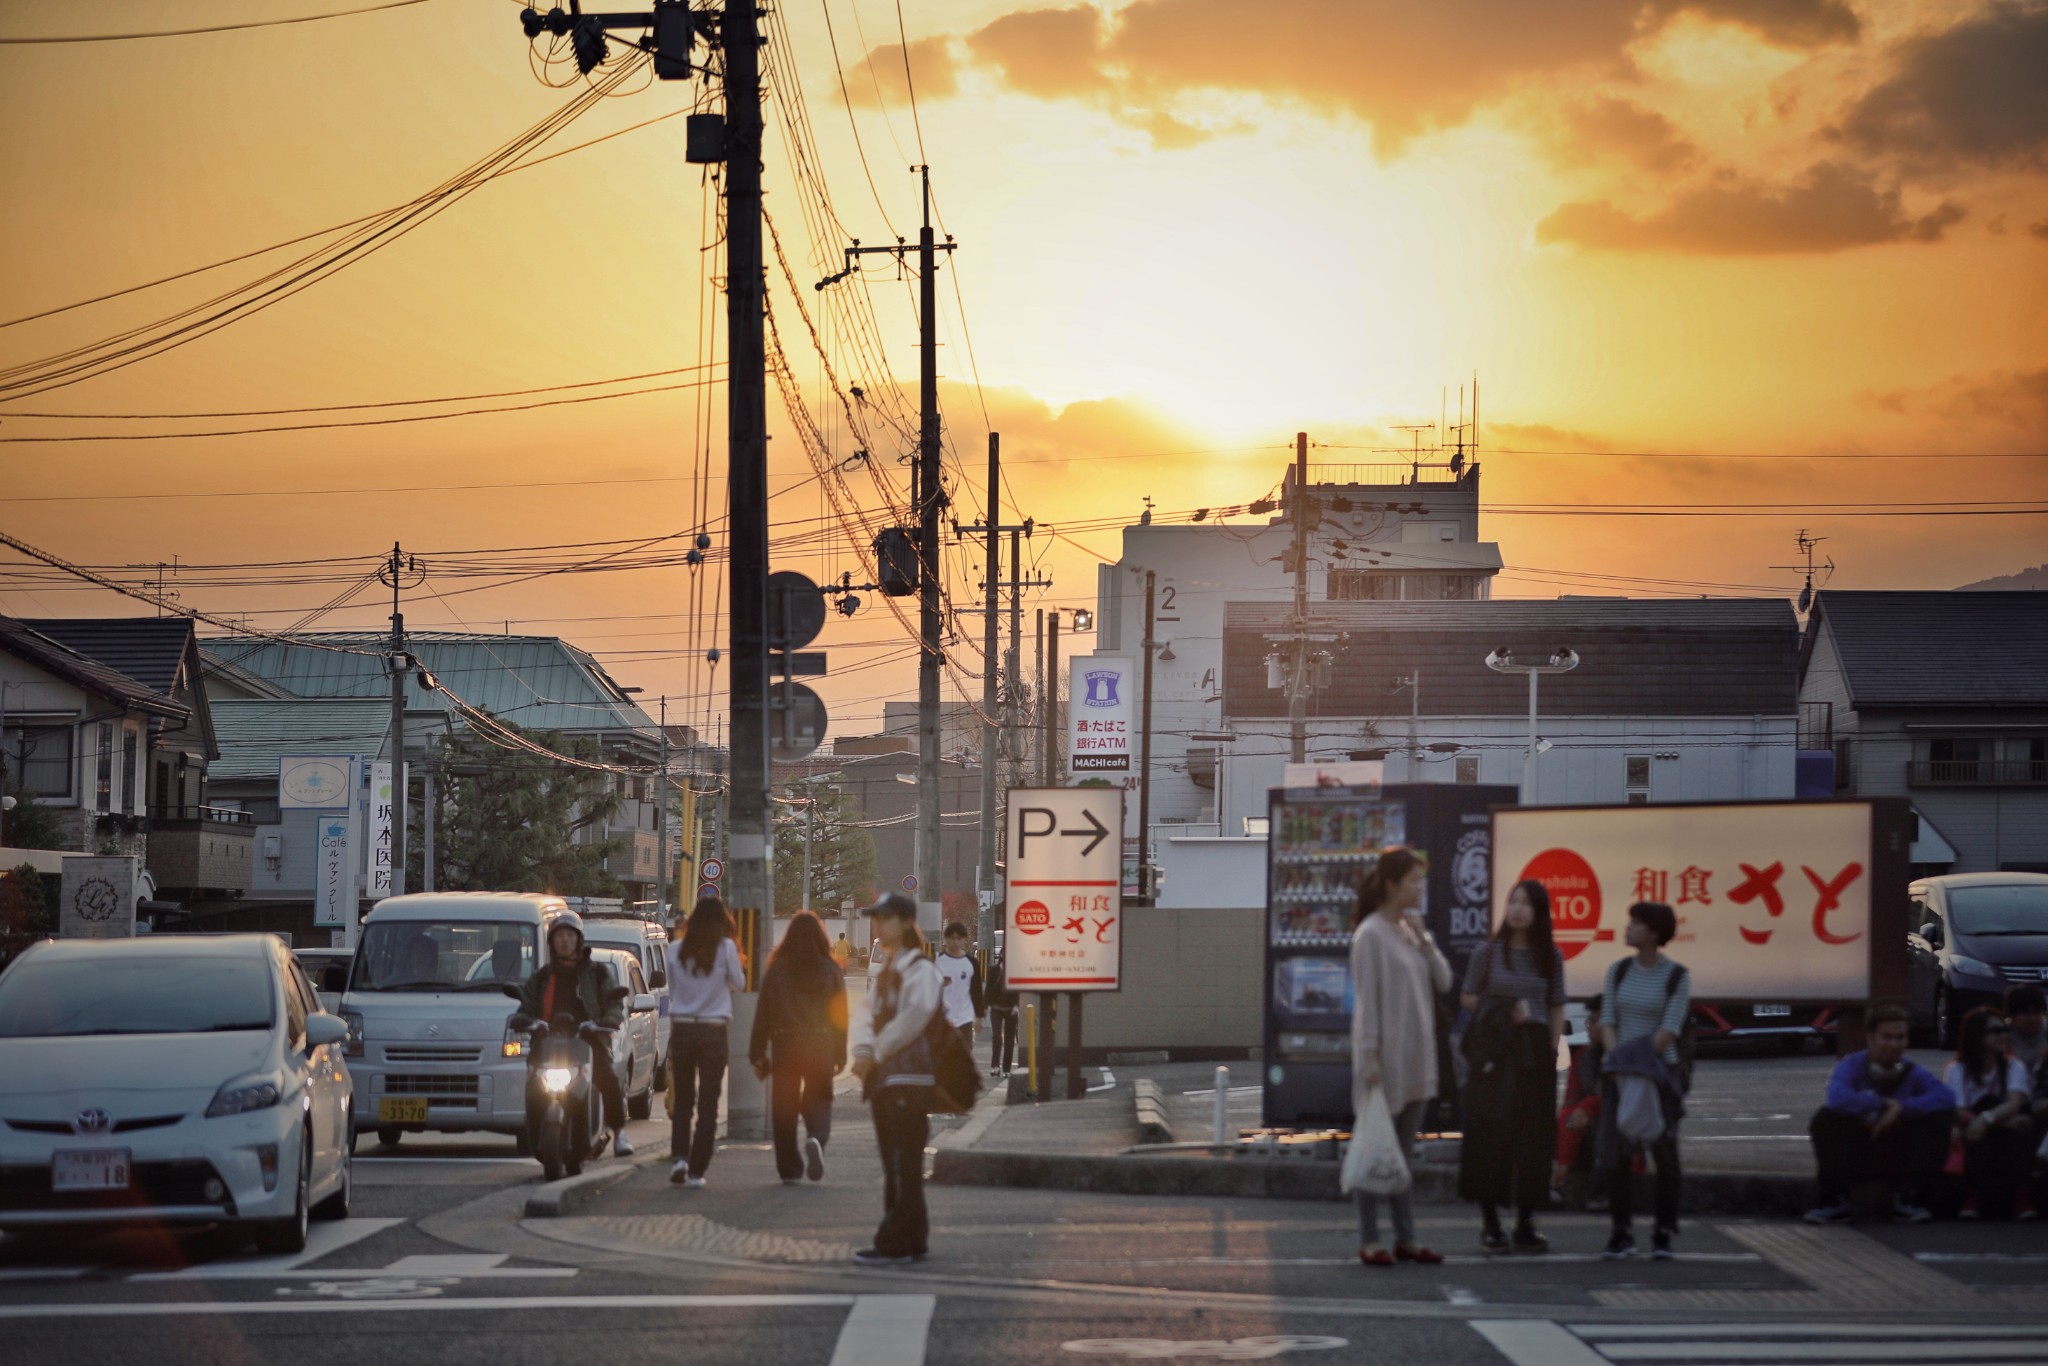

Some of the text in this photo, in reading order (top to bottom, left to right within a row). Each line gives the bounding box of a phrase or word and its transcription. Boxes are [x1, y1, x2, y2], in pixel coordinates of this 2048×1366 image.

[1161, 586, 1176, 610] 2
[1086, 671, 1119, 681] LAWSON
[1086, 698, 1118, 707] STATION
[1077, 737, 1126, 749] 銀行ATM
[1075, 758, 1126, 767] MACHI café
[1018, 808, 1056, 858] P
[322, 837, 347, 848] Café
[705, 865, 718, 876] 40
[1070, 895, 1111, 912] 和食
[1632, 861, 1863, 945] 和食 さと
[1019, 914, 1047, 924] SATO
[1062, 916, 1116, 944] さと
[104, 1165, 126, 1185] 18
